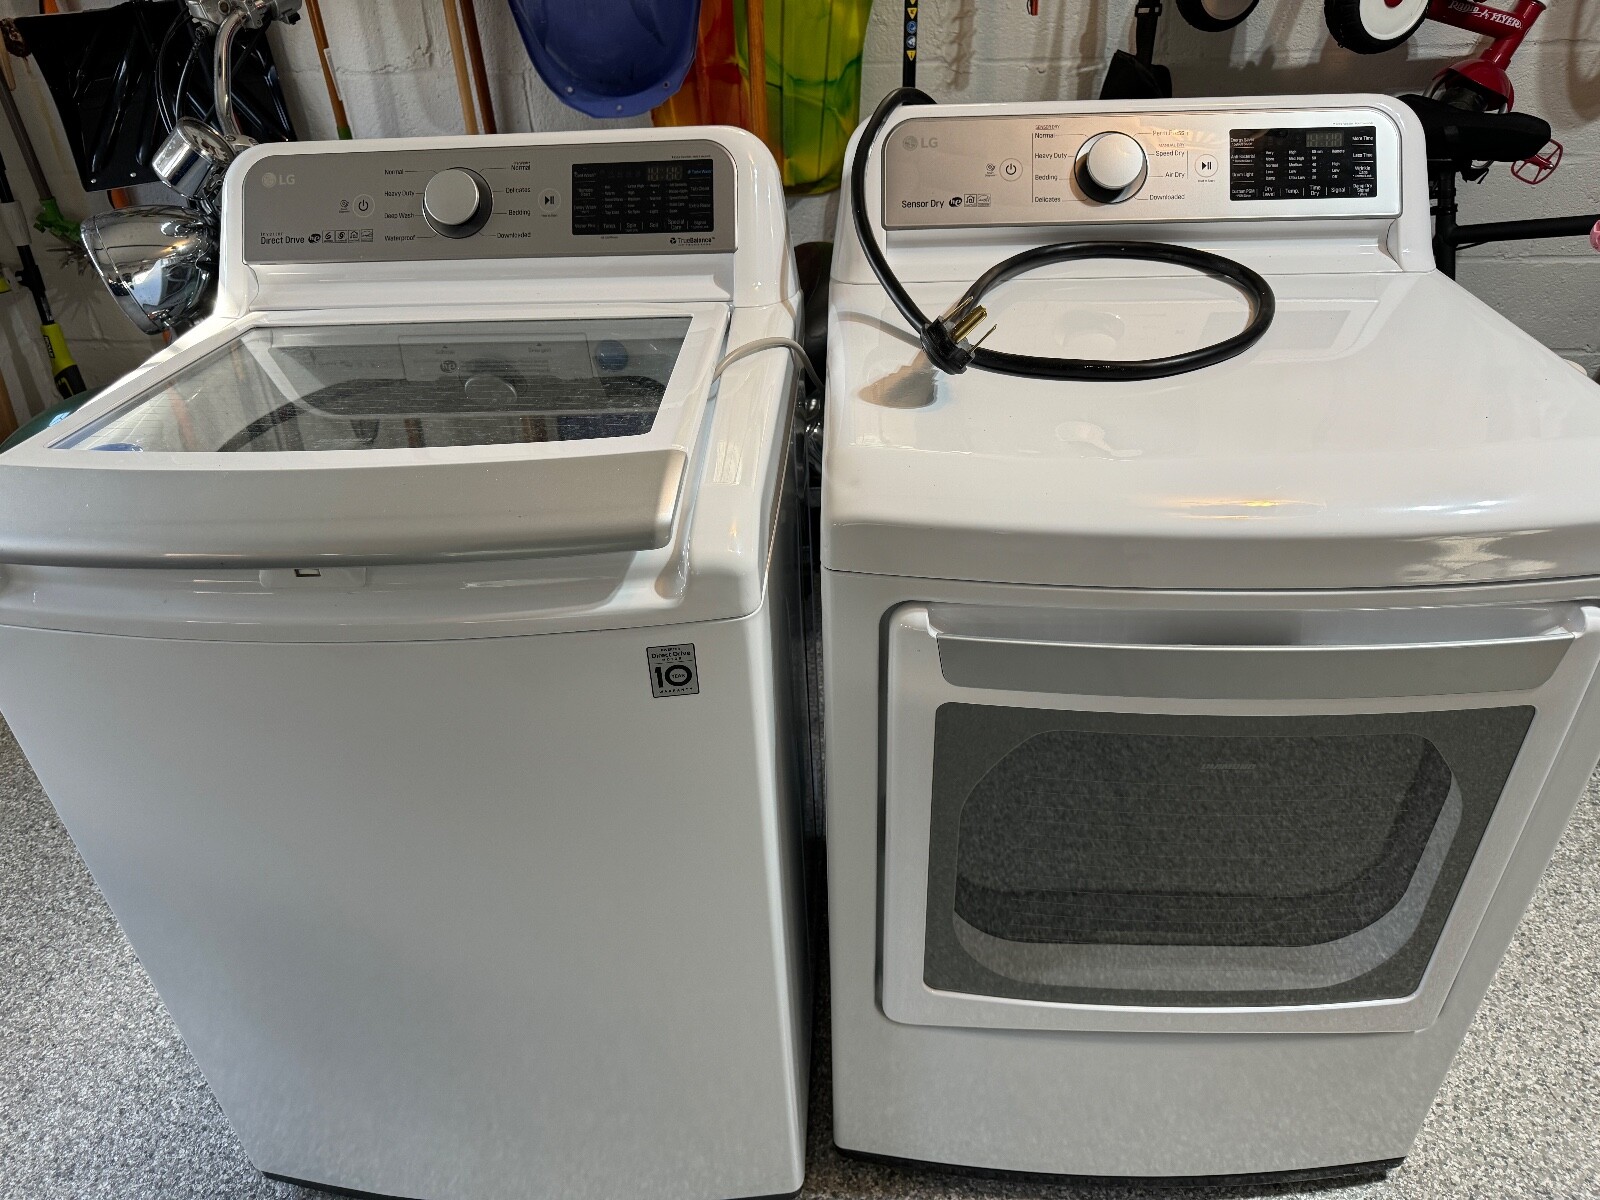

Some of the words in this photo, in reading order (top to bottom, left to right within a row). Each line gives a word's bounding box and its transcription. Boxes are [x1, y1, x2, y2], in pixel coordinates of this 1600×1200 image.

[1490, 12, 1522, 29] FLYER
[921, 138, 938, 148] LG
[1034, 152, 1053, 160] Heavy
[1155, 150, 1173, 158] Speed
[278, 174, 295, 185] LG
[384, 190, 401, 198] Heavy
[901, 200, 929, 209] Sensor
[930, 199, 945, 209] Dry
[384, 212, 398, 220] Deep
[508, 209, 531, 217] Bedding
[384, 234, 416, 242] Waterproof
[496, 231, 532, 239] Downloaded
[260, 236, 284, 245] Direct
[285, 234, 305, 244] Drive
[655, 664, 692, 688] 10
